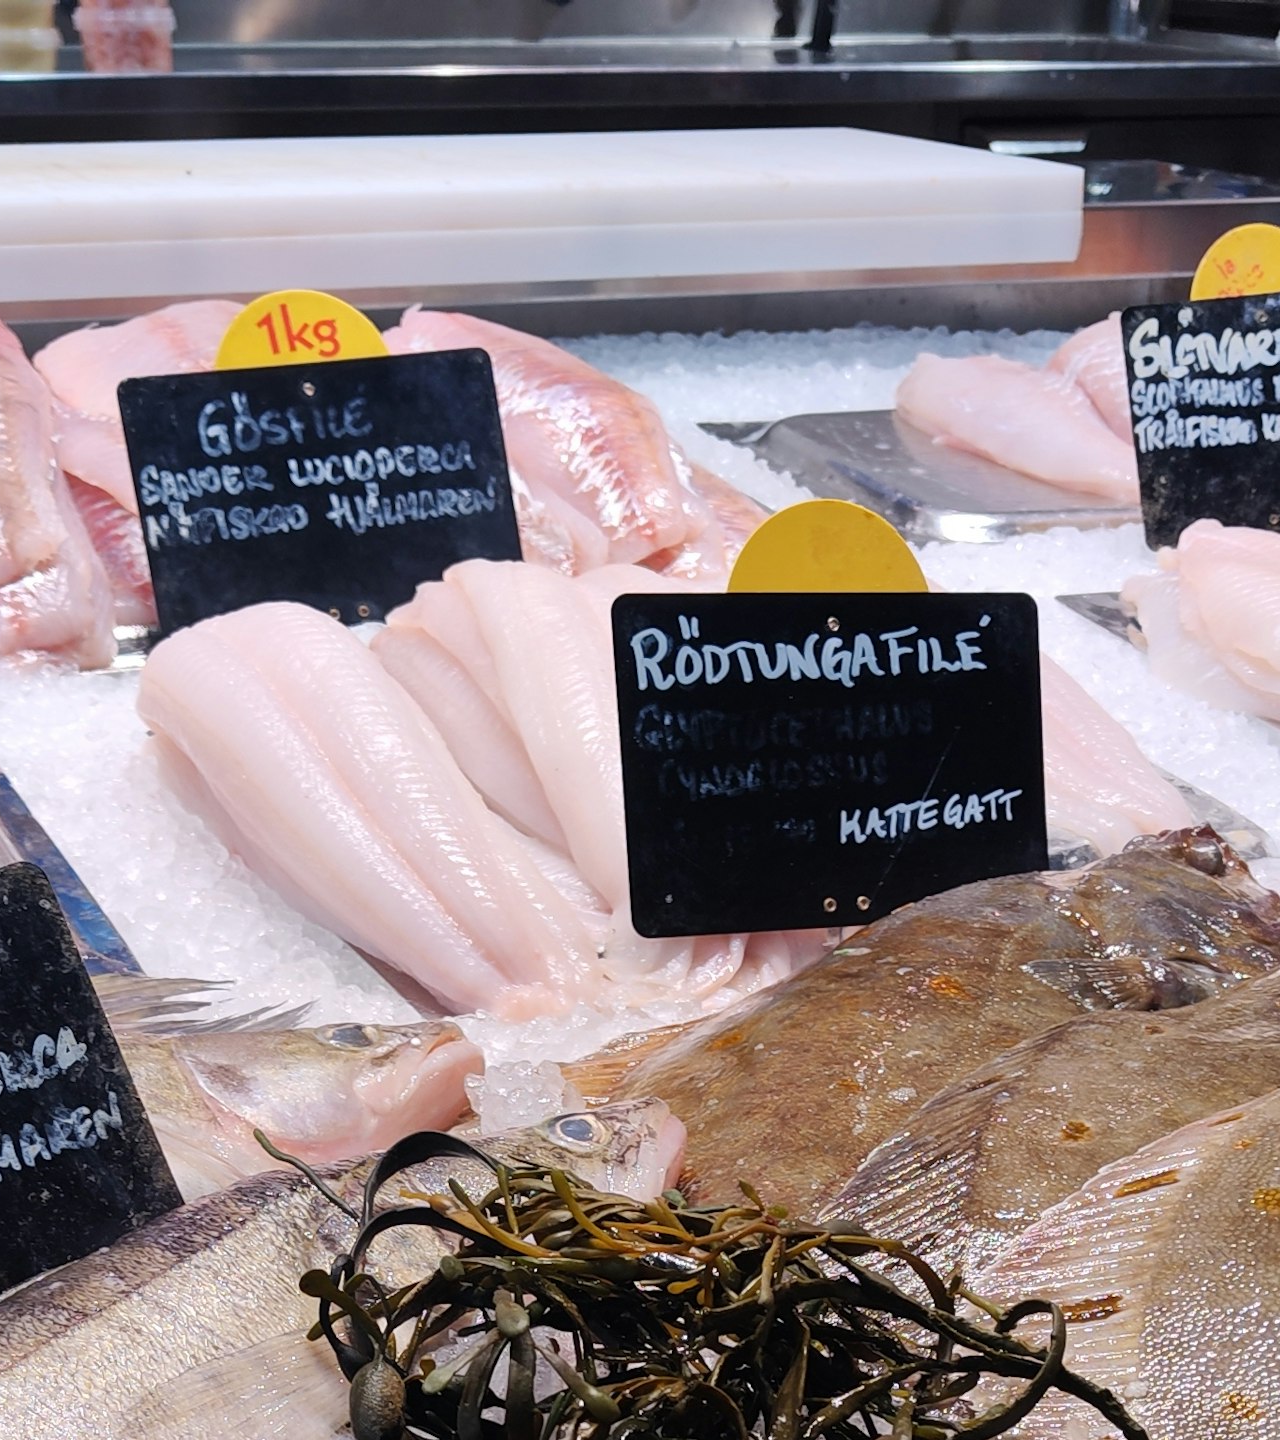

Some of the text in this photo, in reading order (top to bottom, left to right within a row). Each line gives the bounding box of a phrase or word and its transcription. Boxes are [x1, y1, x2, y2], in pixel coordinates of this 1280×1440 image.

[255, 302, 342, 358] 1kg
[138, 464, 274, 507] SANDER
[629, 613, 993, 691] RÖDTUNGAFILÉ
[838, 788, 1024, 845] KATTEGATT
